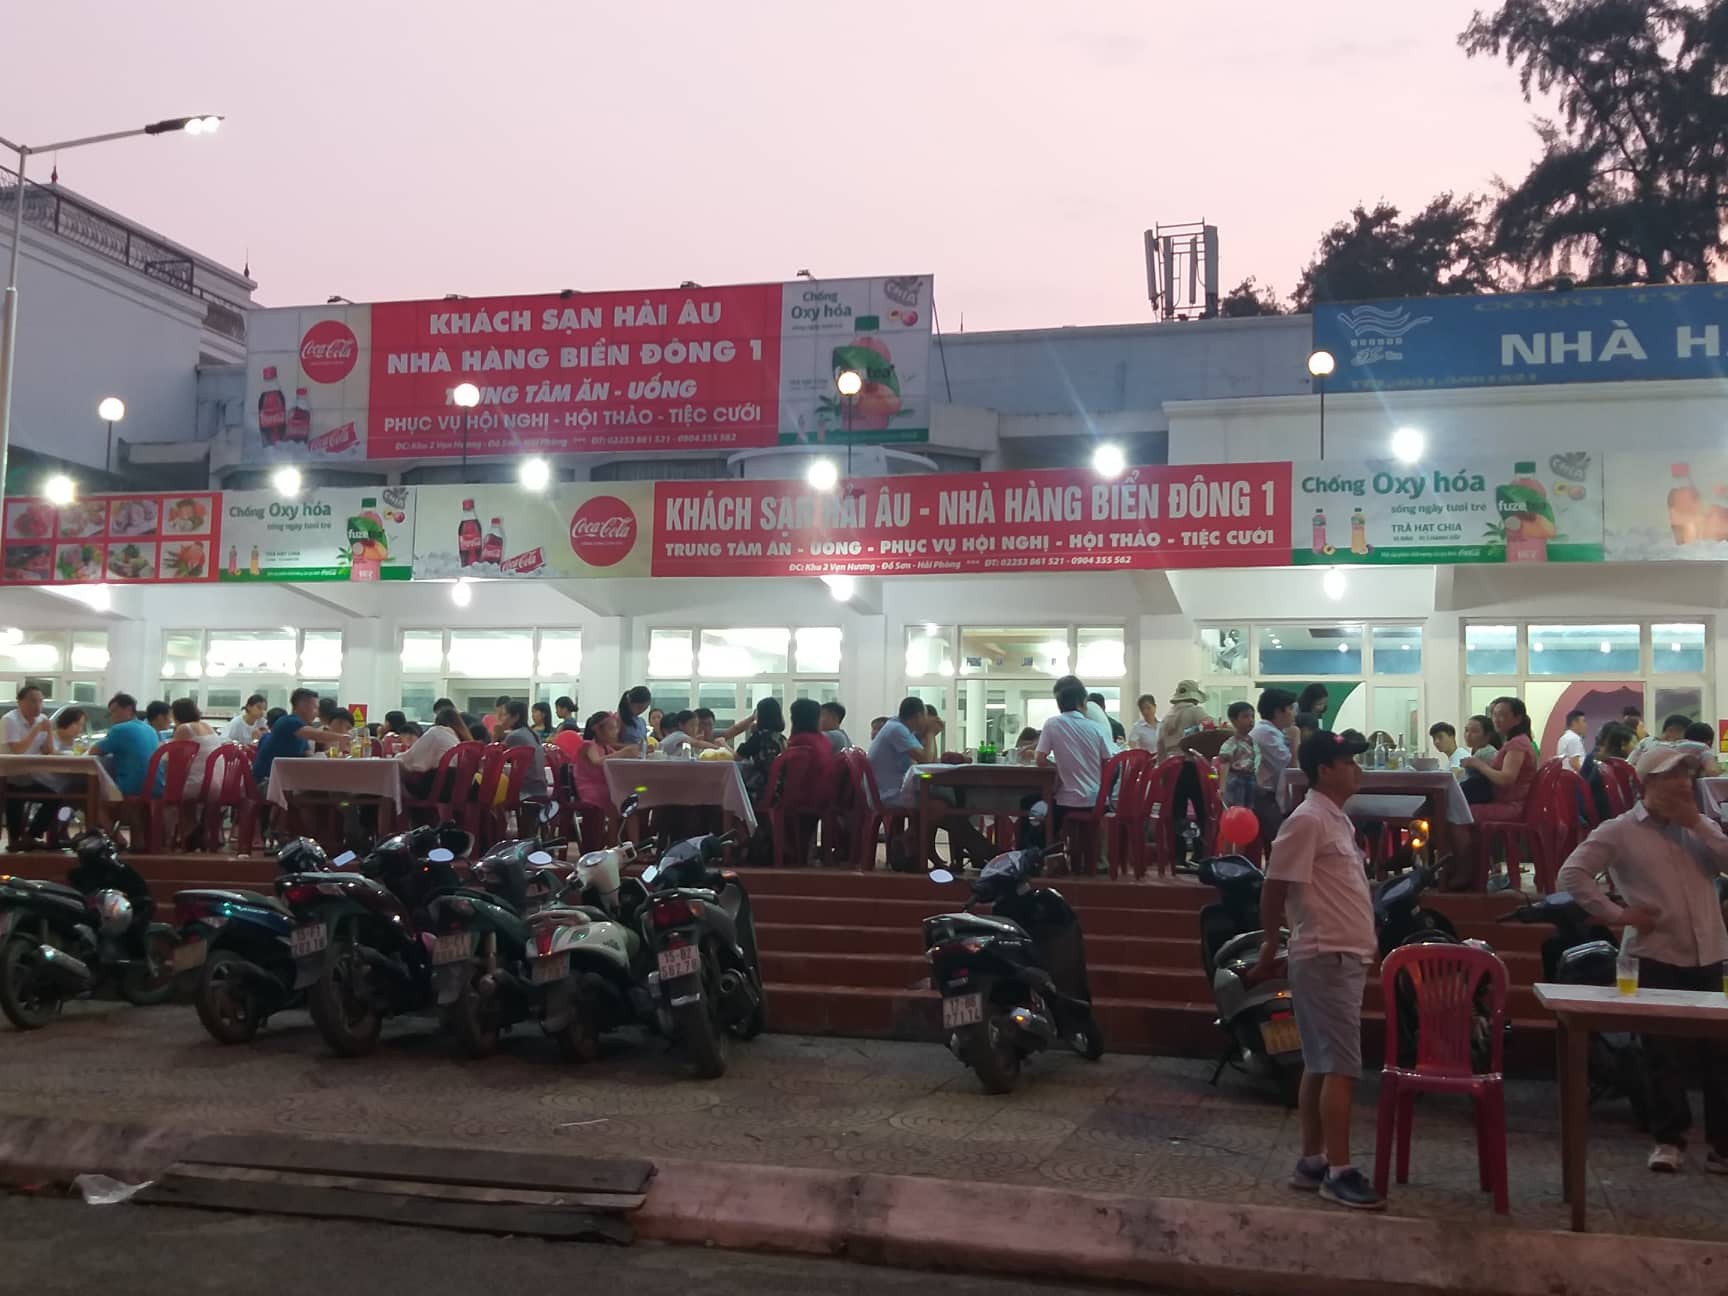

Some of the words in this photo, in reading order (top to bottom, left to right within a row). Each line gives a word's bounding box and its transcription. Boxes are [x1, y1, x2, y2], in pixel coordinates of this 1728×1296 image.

[430, 307, 531, 335] KHÁCH
[541, 307, 602, 335] SẠN
[614, 299, 667, 328] HẢI
[677, 299, 722, 325] ÂU
[791, 305, 820, 321] Oxy
[824, 303, 852, 317] hóa
[387, 348, 452, 374] NHÀ
[462, 346, 549, 371] HÀNG
[560, 338, 629, 368] BIỂN
[640, 338, 736, 365] ĐÔNG
[750, 340, 762, 361] 1
[1501, 320, 1648, 366] NHÀ
[1676, 324, 1728, 358] H
[446, 386, 519, 405] TNG
[526, 380, 570, 403] TÂM
[575, 378, 610, 402] ĂN
[627, 372, 697, 400] UỐNG
[384, 415, 432, 435] PHỤC
[438, 415, 461, 433] VỤ
[467, 411, 498, 433] HỘI
[504, 413, 549, 431] NGHỊ
[565, 408, 597, 430] HỘI
[603, 405, 653, 425] THẢO
[669, 404, 707, 427] TIỆC
[713, 402, 761, 422] CƯỚI
[1302, 474, 1366, 496] Chống
[1372, 471, 1426, 499] Oxy
[1433, 468, 1486, 493] hóa
[229, 505, 264, 519] Chống
[269, 502, 299, 520] Oxy
[302, 500, 331, 517] hóa
[665, 489, 751, 531] KHÁCH
[875, 486, 911, 528] ÂU
[939, 482, 996, 525] NHÀ
[1004, 480, 1082, 523] HÀNG
[1091, 470, 1159, 521] BIỂN
[1168, 474, 1250, 518] ĐÔNG
[1261, 481, 1274, 516] 1
[1498, 501, 1528, 512] fuze
[665, 543, 722, 557] TRUNG
[880, 538, 928, 557] PHỤC
[932, 538, 956, 555] VỤ
[962, 534, 995, 554] HỘI
[1001, 535, 1049, 552] NGHỊ
[1069, 531, 1103, 551] HỘI
[1110, 529, 1161, 548] THẢO
[1181, 528, 1220, 549] TIỆC
[1226, 526, 1274, 545] CƯỚI
[1437, 522, 1462, 532] CHIA
